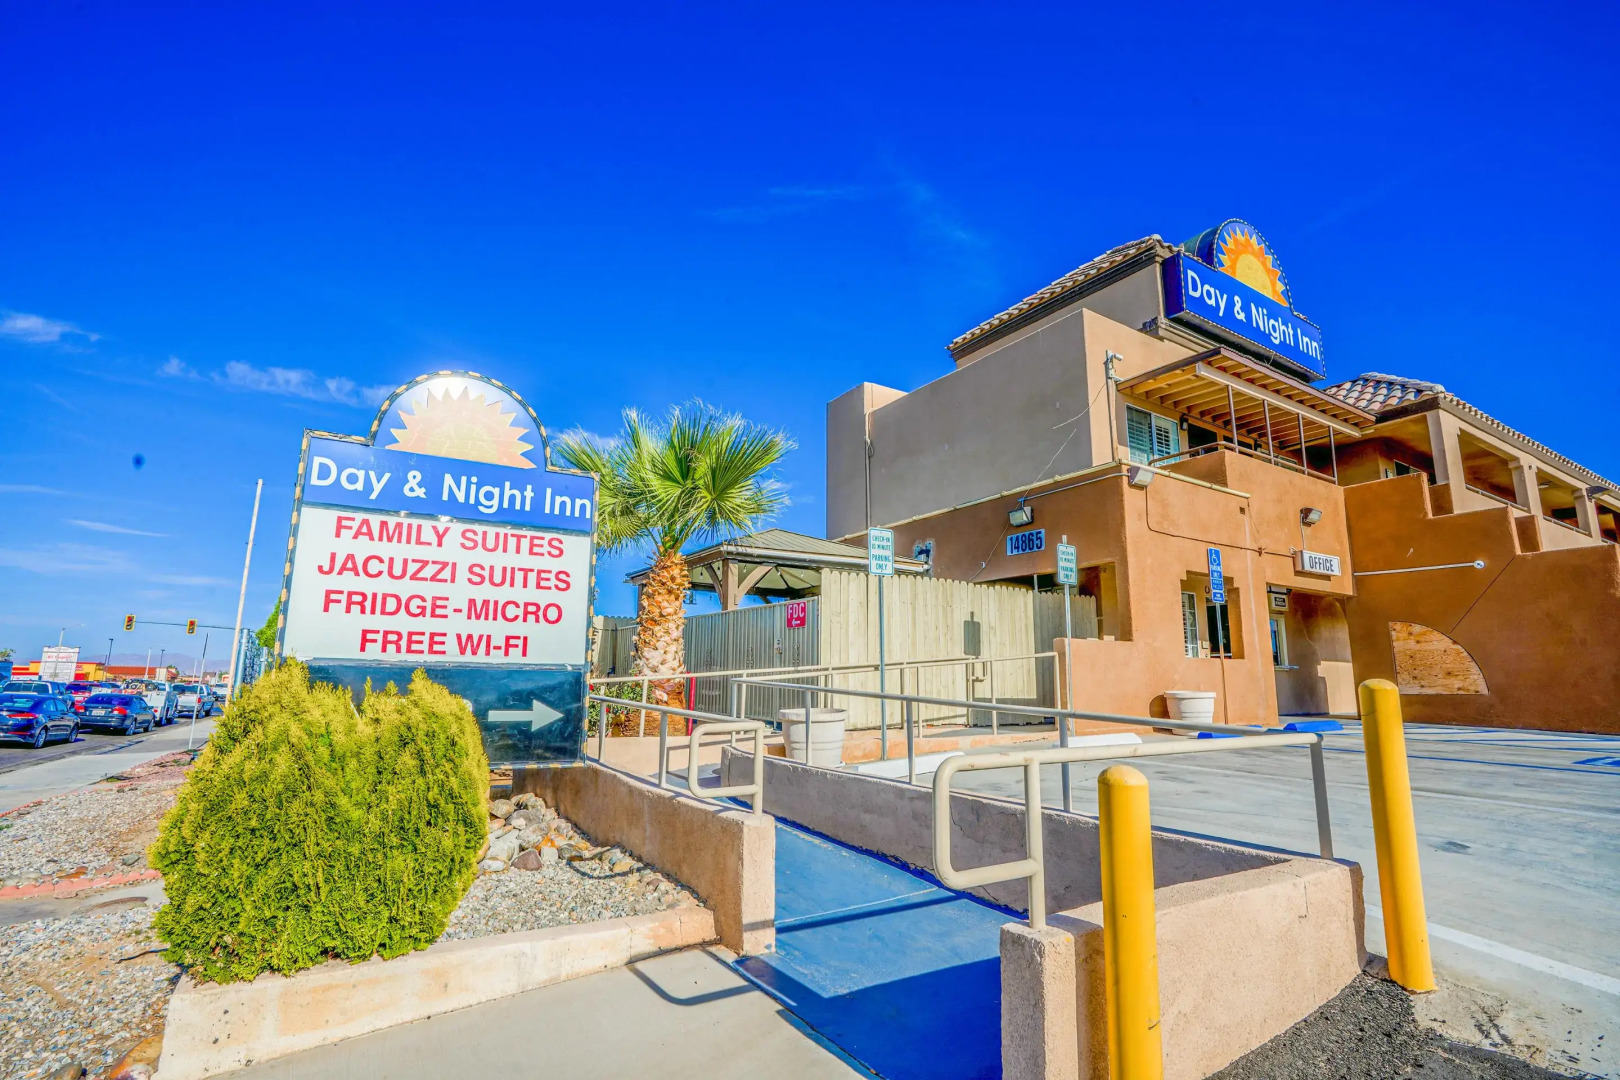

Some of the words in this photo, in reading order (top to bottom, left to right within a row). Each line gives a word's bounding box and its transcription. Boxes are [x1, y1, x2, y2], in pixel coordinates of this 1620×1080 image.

[1187, 269, 1227, 317] Day
[1234, 295, 1247, 322] &
[1251, 302, 1294, 347] Night
[1297, 327, 1321, 360] Inn
[310, 456, 391, 500] Day
[403, 470, 427, 498] &
[442, 473, 534, 514] Night
[545, 487, 592, 519] Inn
[334, 516, 451, 548] FAMILY
[459, 528, 564, 558] SUITES
[1009, 530, 1043, 554] 14865
[317, 551, 457, 584] JACUZZI
[467, 563, 571, 592] SUITES
[872, 554, 891, 562] PARKING
[1308, 556, 1335, 572] OFFICE
[322, 589, 563, 625] FRIDGE-MICRO
[788, 602, 805, 619] FDC
[359, 629, 447, 655] FREE
[455, 632, 529, 658] WI-FI
